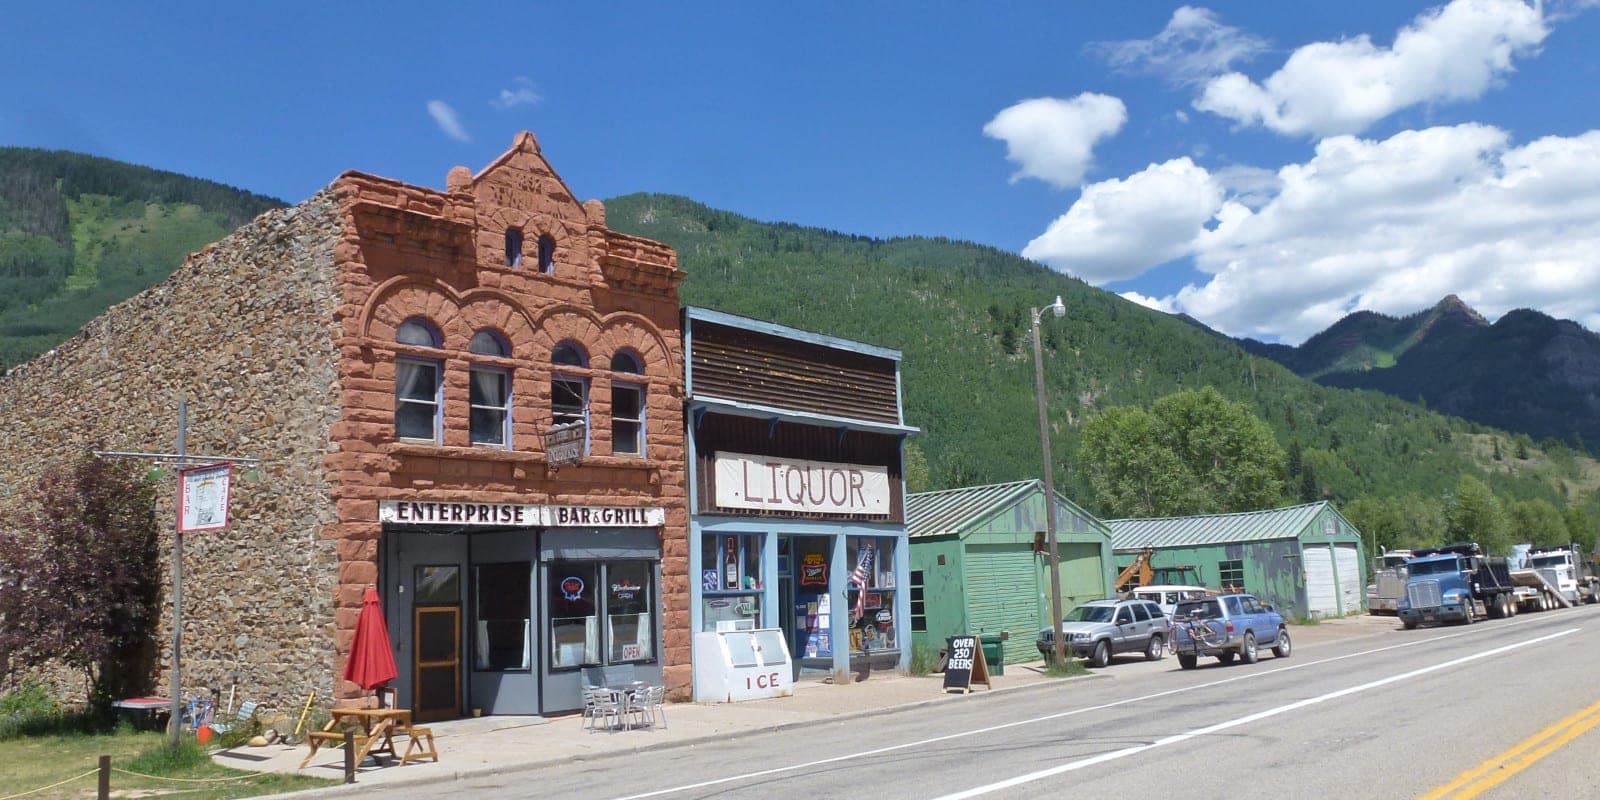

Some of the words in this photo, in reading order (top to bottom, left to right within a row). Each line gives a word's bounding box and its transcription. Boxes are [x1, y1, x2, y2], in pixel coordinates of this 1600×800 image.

[743, 461, 866, 508] LIQUOR
[397, 502, 524, 522] ENTERPRISE
[953, 638, 974, 648] OVER
[623, 646, 640, 658] OPEN
[954, 648, 970, 658] 250
[948, 658, 972, 670] BEERS
[746, 672, 779, 689] ICE
